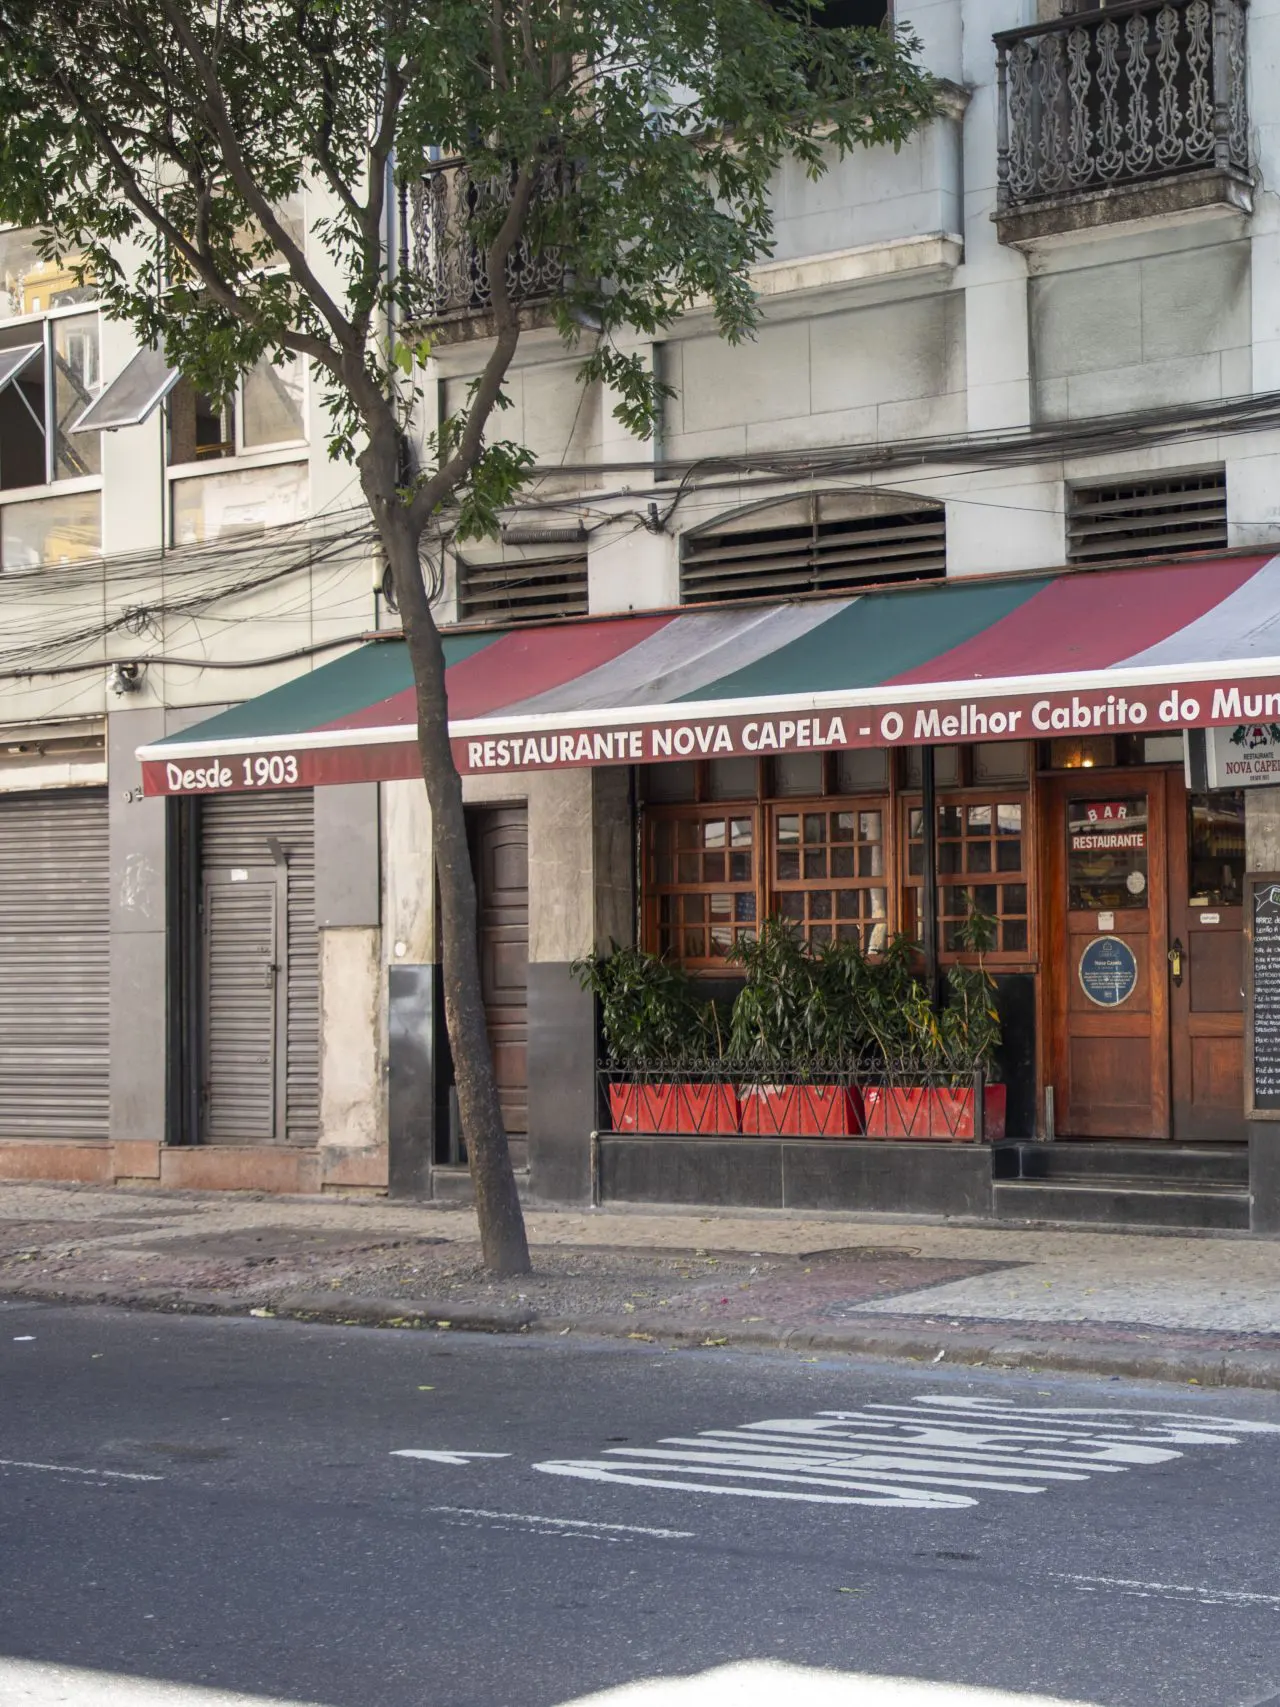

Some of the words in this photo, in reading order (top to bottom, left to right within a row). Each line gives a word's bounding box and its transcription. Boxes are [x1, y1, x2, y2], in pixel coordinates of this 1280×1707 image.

[468, 731, 643, 768] RESTAURANTE
[653, 724, 734, 756] NOVA
[742, 717, 848, 750] CAPELA
[880, 711, 904, 741] O
[914, 705, 1022, 738] Melhor
[1031, 695, 1148, 731] Cabrito
[1158, 689, 1201, 723] do
[1244, 752, 1274, 760] RESTAURANTE
[167, 758, 232, 791] Desde
[243, 755, 298, 786] 1903
[1226, 762, 1252, 775] NOVA
[1088, 806, 1127, 822] BAR
[1073, 834, 1144, 849] RESTAURANTE
